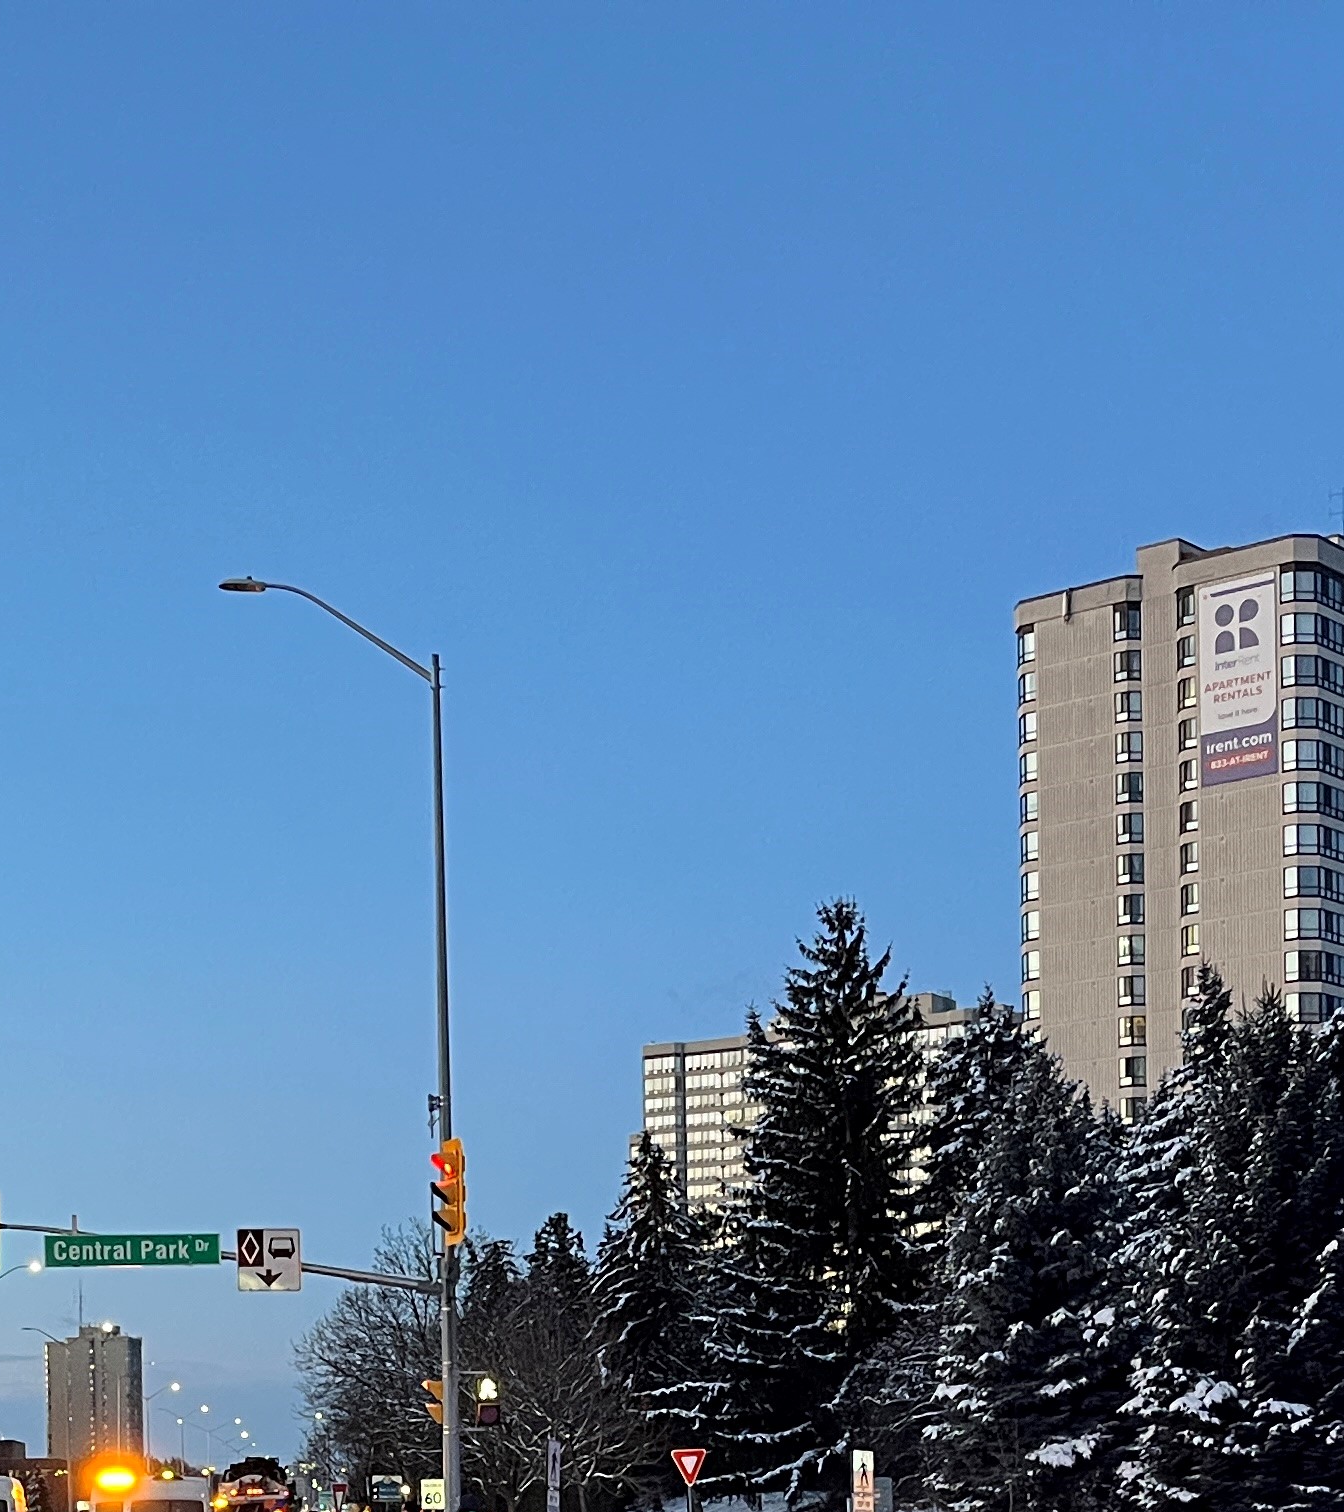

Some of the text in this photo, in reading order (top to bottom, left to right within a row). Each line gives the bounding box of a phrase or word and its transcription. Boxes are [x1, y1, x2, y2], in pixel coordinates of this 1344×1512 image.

[1204, 670, 1271, 694] APARTMENT
[1214, 685, 1263, 704] RENTALS
[1206, 732, 1272, 755] irent.com
[53, 1239, 210, 1261] Central Park Dr
[425, 1492, 441, 1504] 60
